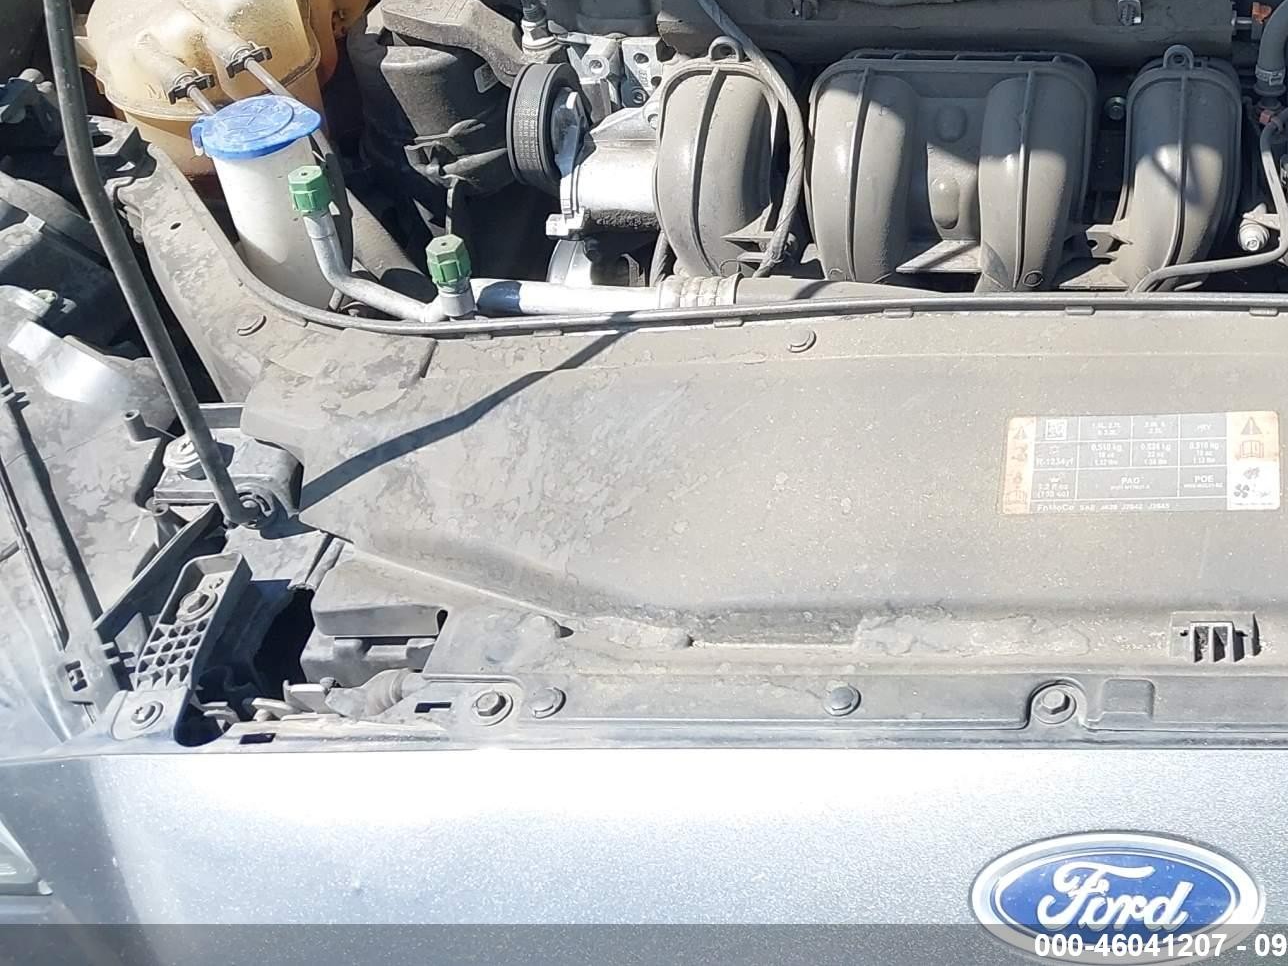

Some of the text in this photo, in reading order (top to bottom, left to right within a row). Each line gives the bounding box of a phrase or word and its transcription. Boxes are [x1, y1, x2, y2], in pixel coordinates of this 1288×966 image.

[1121, 476, 1140, 484] PAG
[1194, 474, 1215, 483] POE
[1036, 861, 1194, 932] Ford
